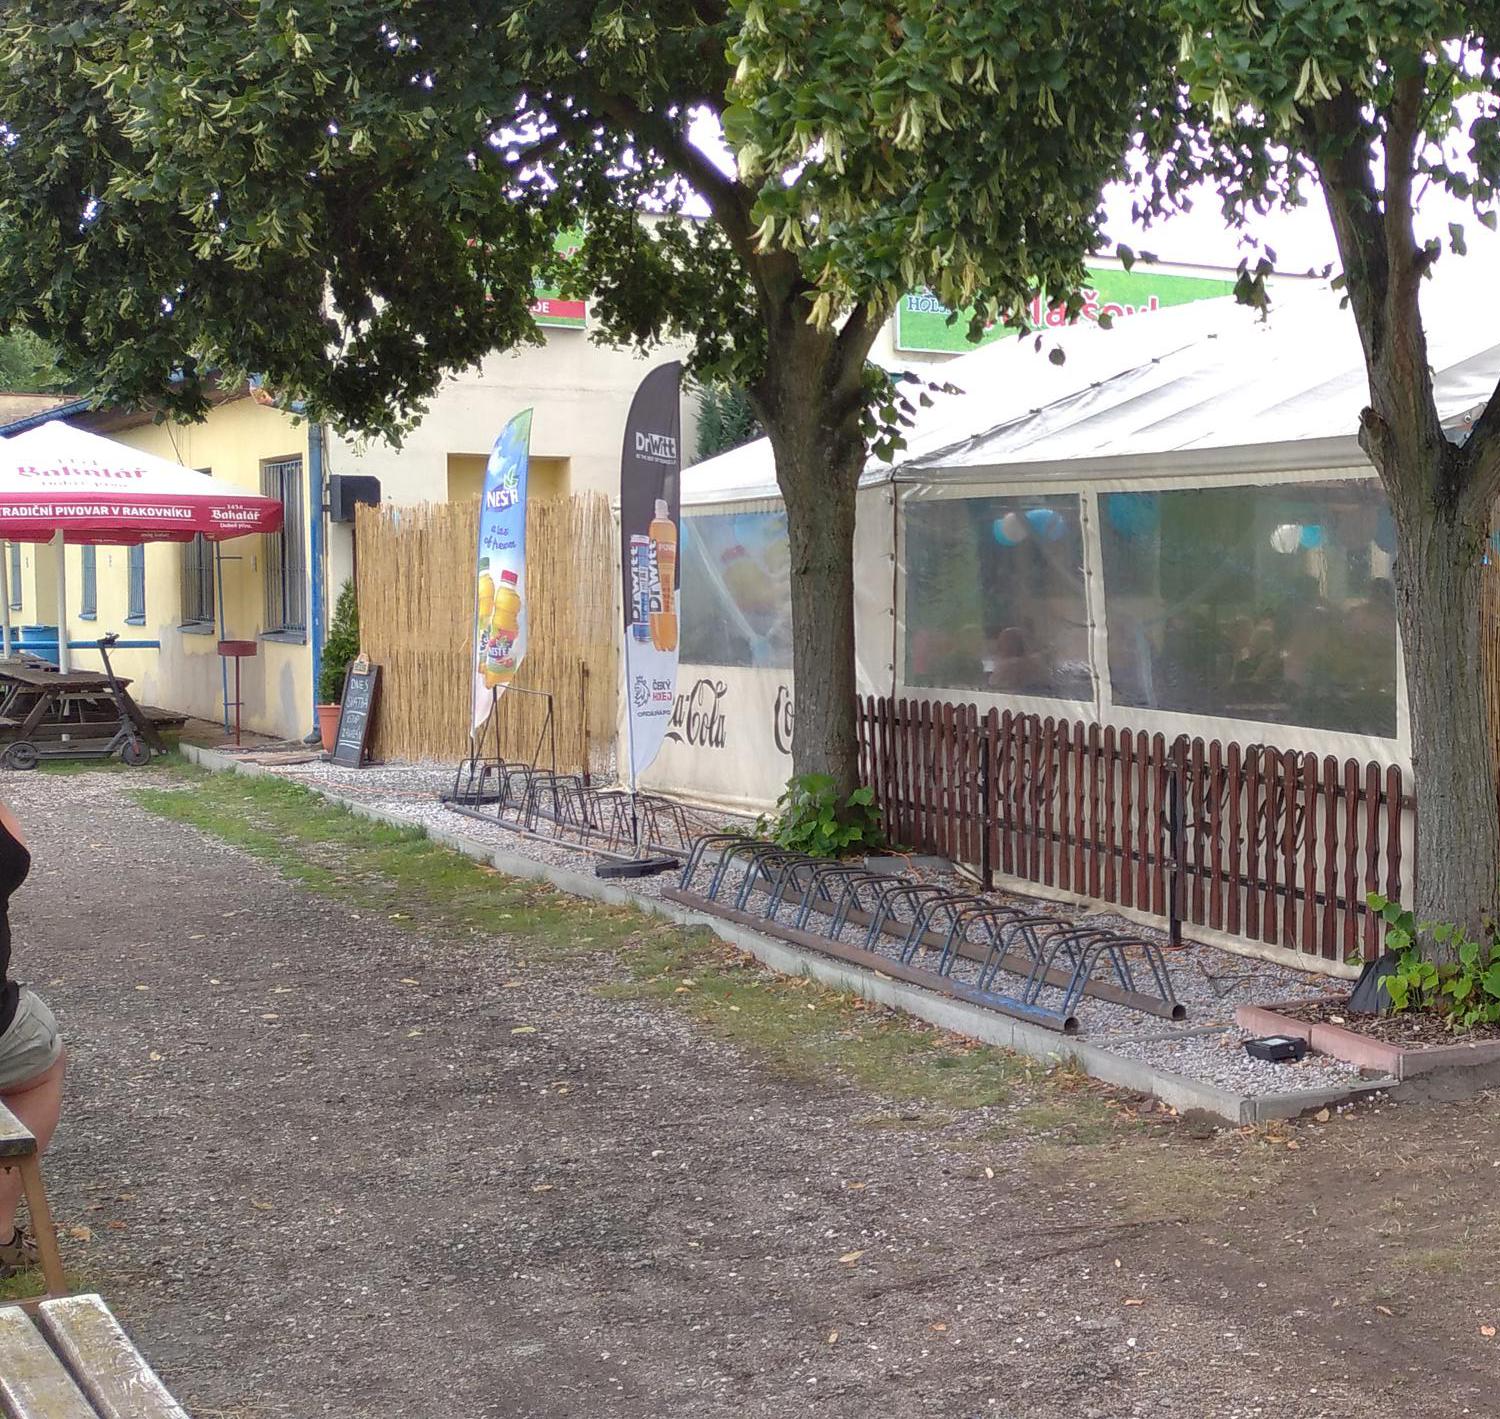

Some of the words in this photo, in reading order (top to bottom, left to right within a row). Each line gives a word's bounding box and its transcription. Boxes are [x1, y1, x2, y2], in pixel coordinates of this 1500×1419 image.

[908, 296, 951, 313] HOL
[0, 504, 52, 516] RADIČNÍ
[55, 506, 108, 516] PIVOVAR
[111, 506, 119, 516] V
[123, 505, 192, 518] RAKOVNÍKU
